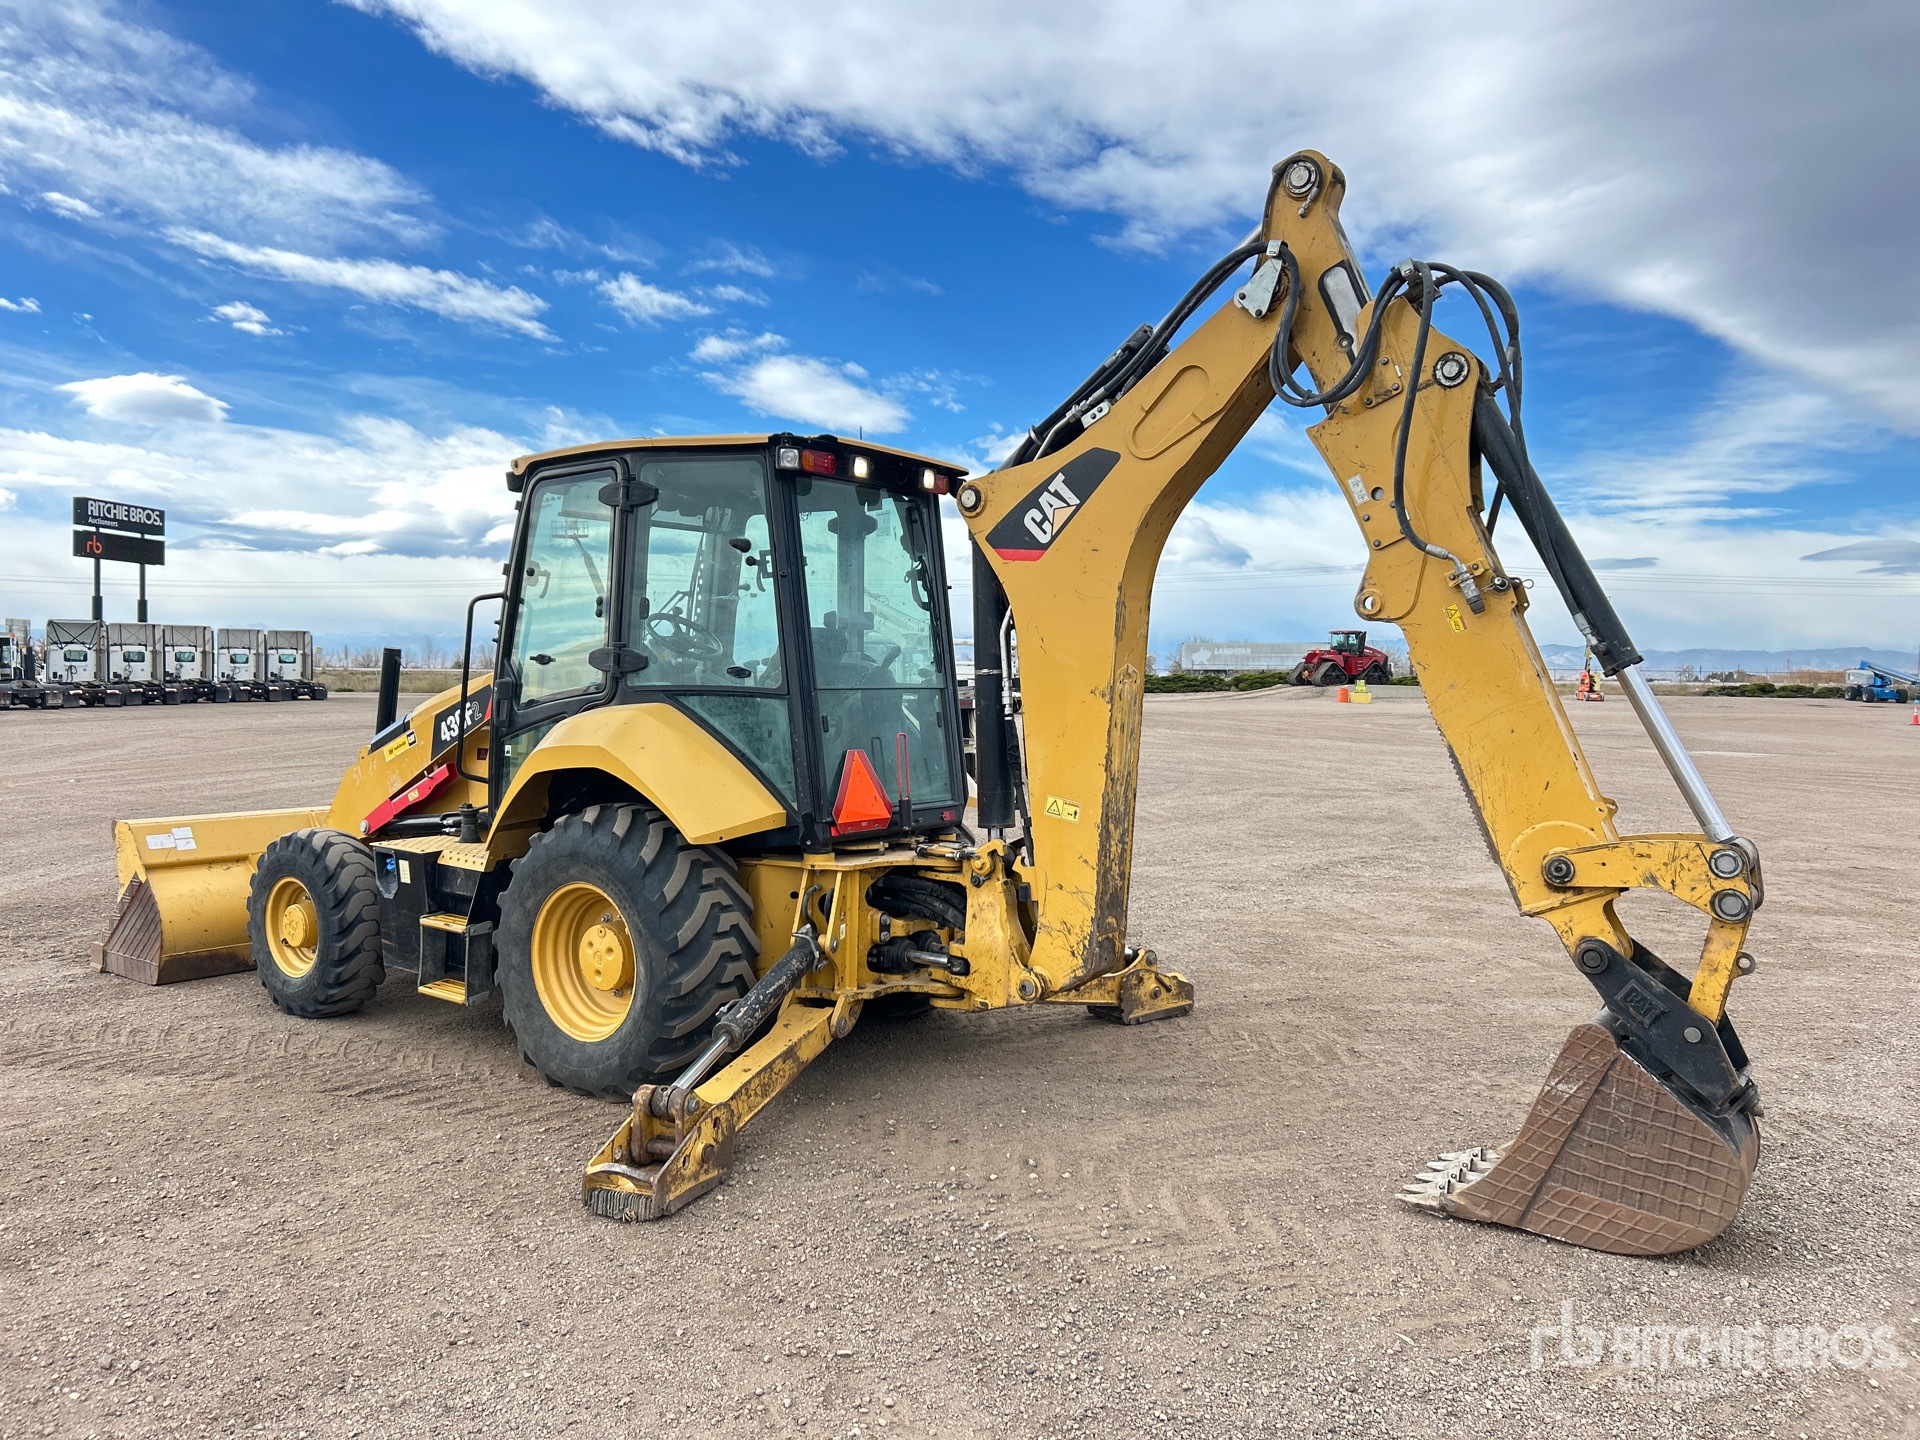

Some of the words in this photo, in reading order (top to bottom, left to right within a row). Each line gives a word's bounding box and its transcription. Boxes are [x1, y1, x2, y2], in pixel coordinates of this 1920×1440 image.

[87, 500, 128, 521] RITCHIE
[129, 507, 163, 526] BROS.
[1024, 472, 1080, 543] CAT
[88, 516, 119, 527] Auctioneers
[86, 535, 103, 554] rb
